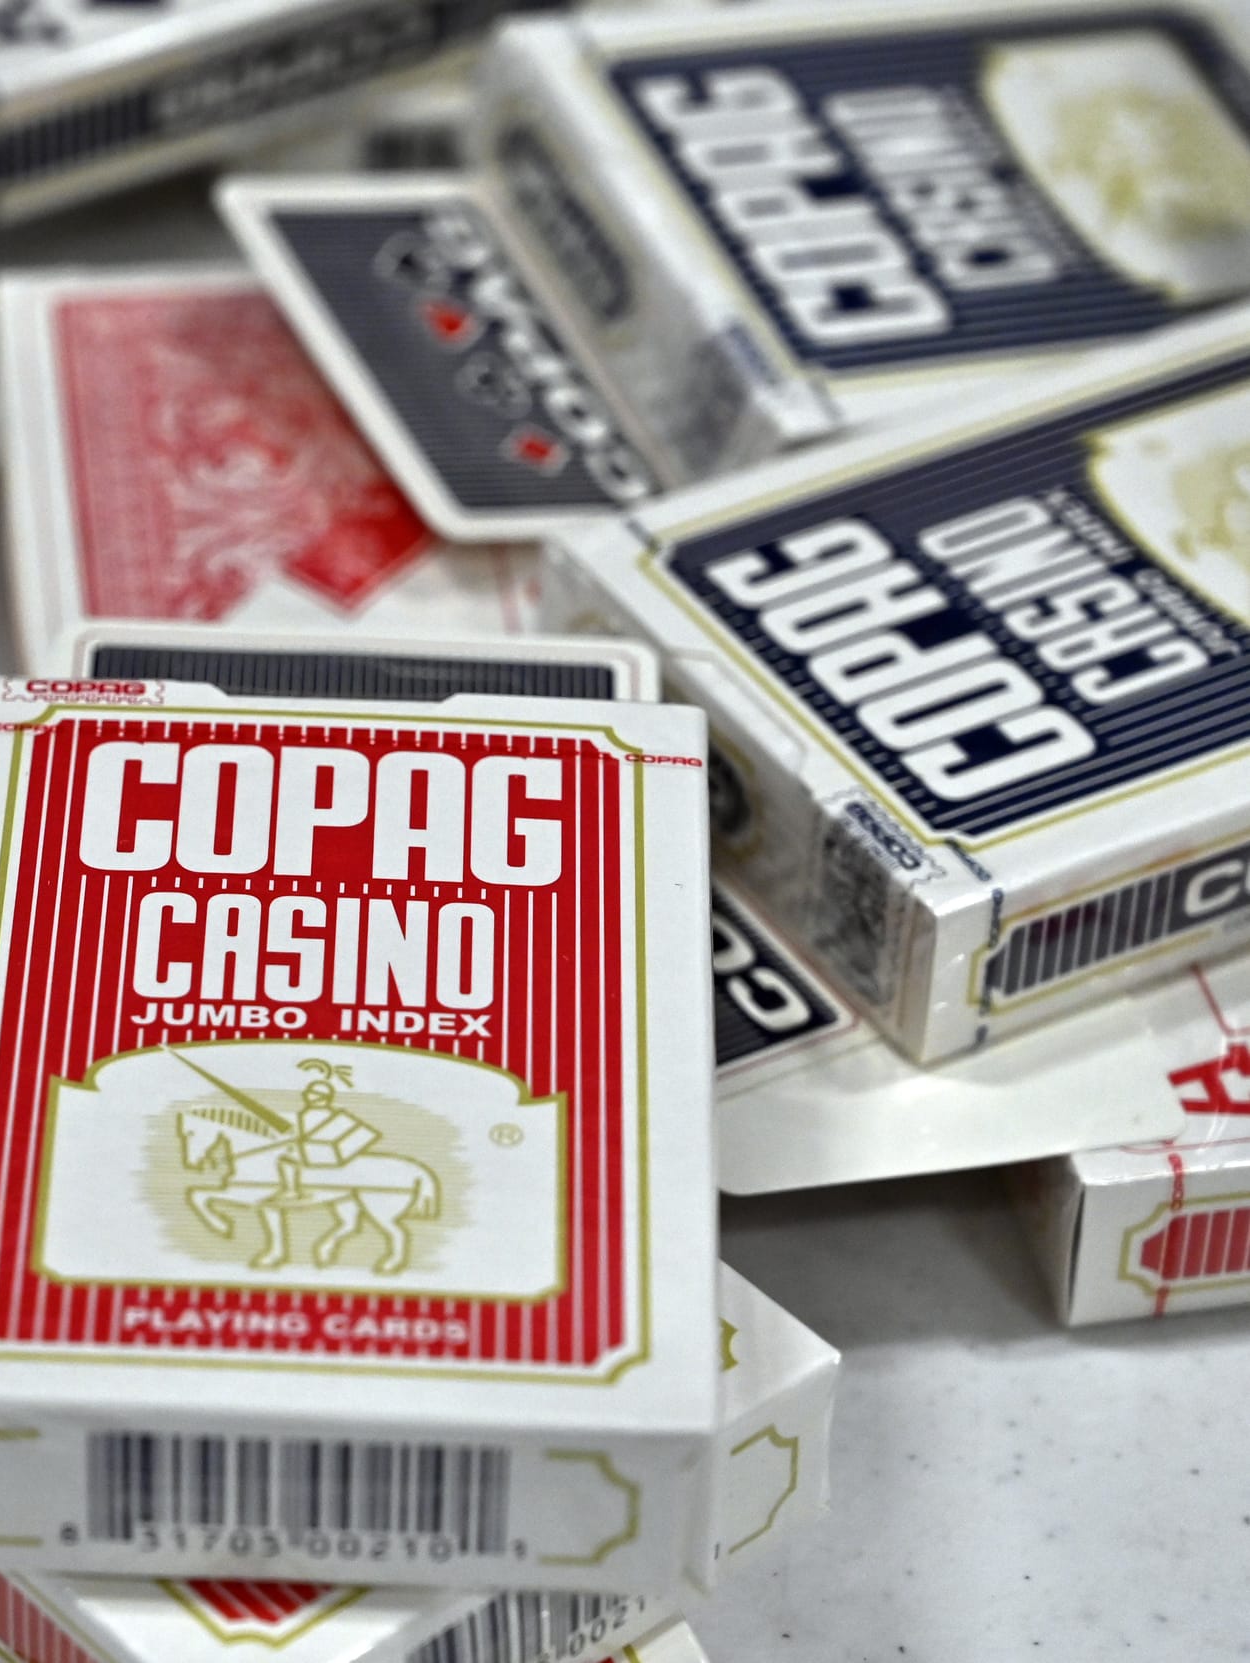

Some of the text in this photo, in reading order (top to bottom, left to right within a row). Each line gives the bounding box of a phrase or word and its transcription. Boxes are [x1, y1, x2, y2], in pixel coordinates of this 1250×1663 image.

[640, 66, 949, 346] COPAG
[917, 499, 1209, 704] CASINO
[706, 518, 1096, 800] COPAG
[625, 753, 703, 768] COPAG
[79, 741, 562, 886] COPAG
[1184, 858, 1250, 917] C
[132, 891, 495, 1010] CASINO
[131, 1003, 492, 1037] JUMBO INDEX
[123, 1310, 468, 1342] PLAYING CARDS
[60, 1522, 79, 1544] 8
[308, 1534, 451, 1562] 00210
